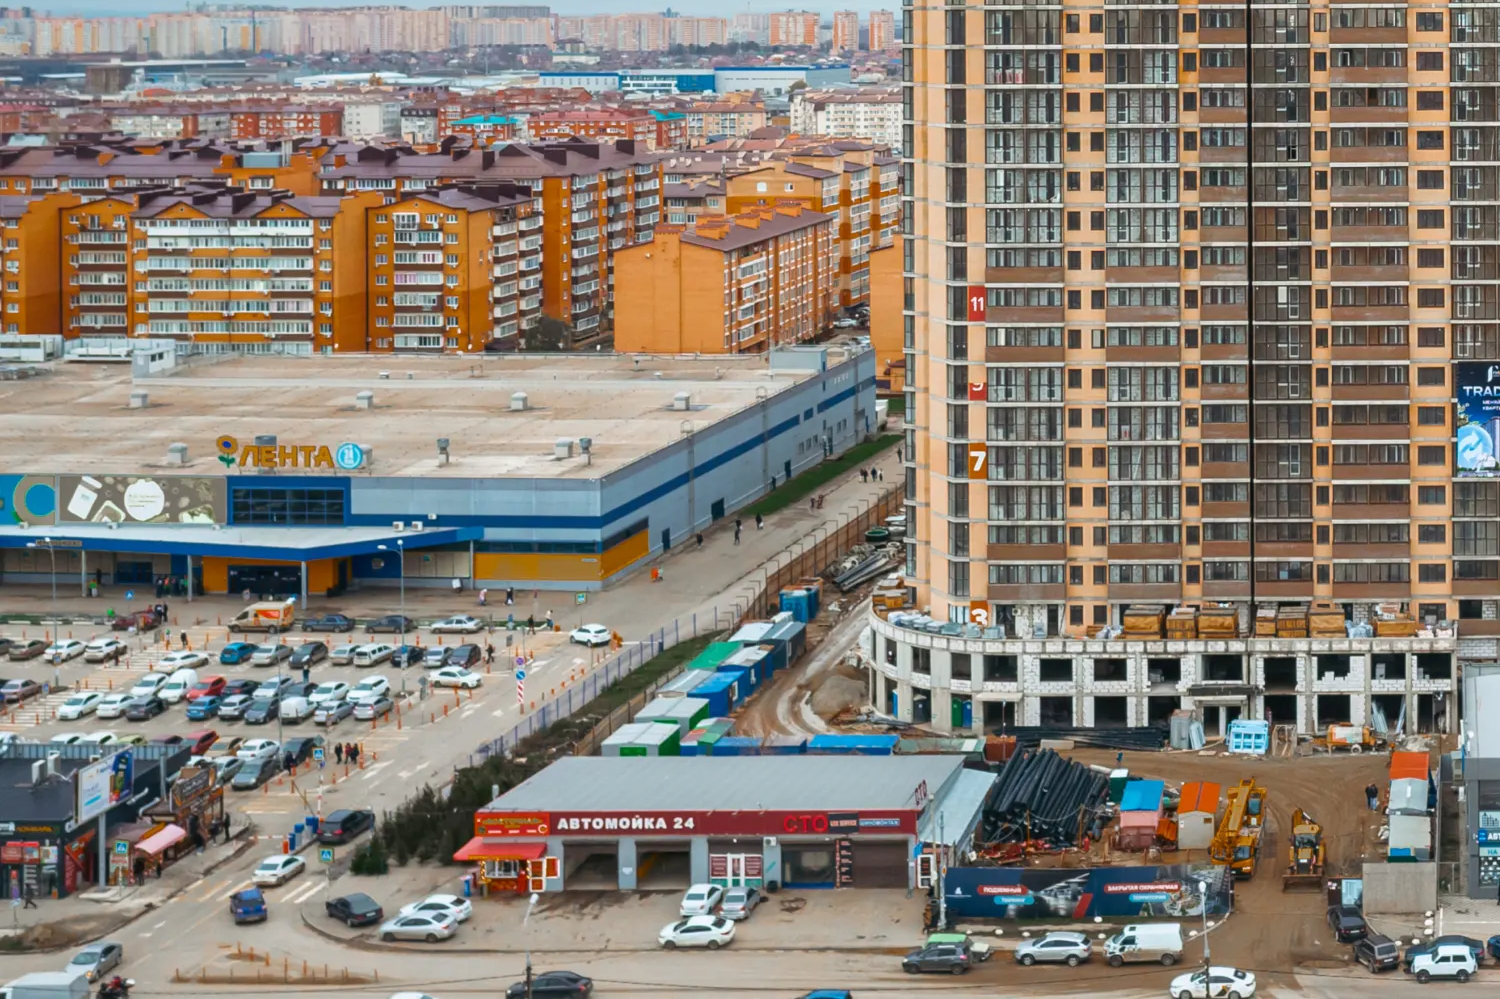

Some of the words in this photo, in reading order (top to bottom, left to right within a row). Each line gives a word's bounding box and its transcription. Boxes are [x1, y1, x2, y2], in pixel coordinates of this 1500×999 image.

[970, 296, 985, 312] 11
[239, 445, 335, 468] ЛЕНТА
[970, 452, 986, 471] 7
[557, 815, 667, 830] АВТОМОЙКА
[673, 817, 695, 830] 24
[783, 814, 828, 833] СТО
